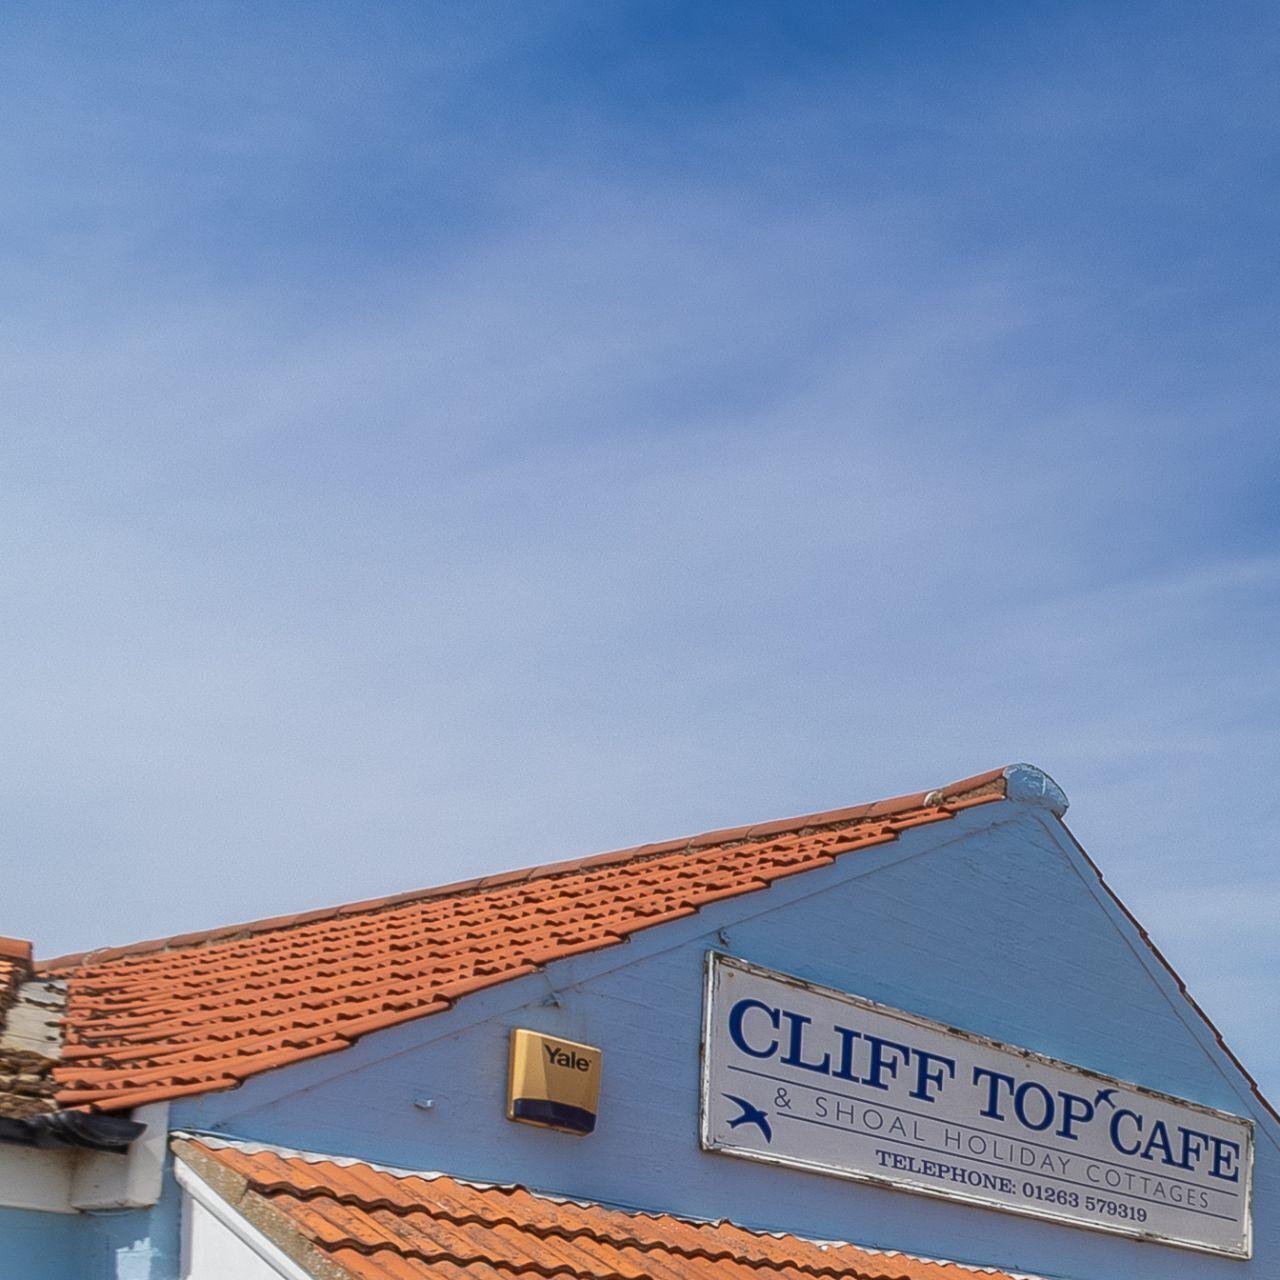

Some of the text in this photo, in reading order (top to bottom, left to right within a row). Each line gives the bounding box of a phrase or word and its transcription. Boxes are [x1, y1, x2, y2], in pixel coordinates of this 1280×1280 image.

[543, 1043, 590, 1073] Yale
[728, 998, 1241, 1184] CLIFF TOP CAFE
[773, 1087, 1209, 1209] & SHOAL HOLIDAY COTTAGES
[875, 1149, 1148, 1223] TELEPHONE: 01263 579319
